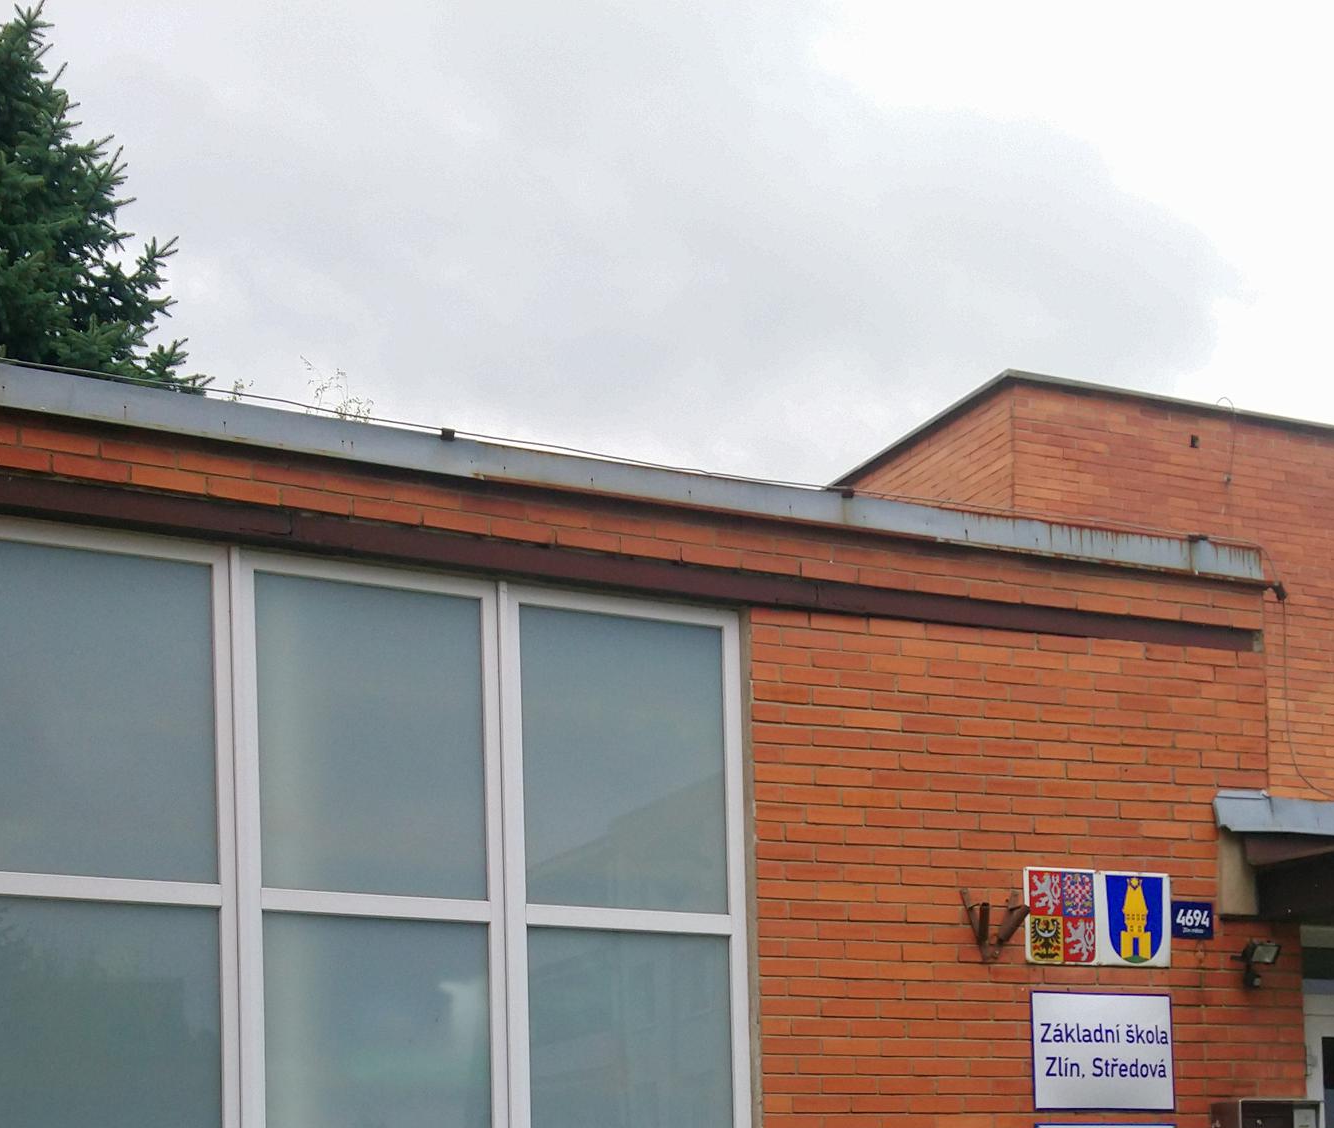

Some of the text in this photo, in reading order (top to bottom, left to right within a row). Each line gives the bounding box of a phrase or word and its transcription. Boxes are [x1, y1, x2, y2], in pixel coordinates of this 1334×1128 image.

[1176, 909, 1210, 927] 4694
[1040, 1023, 1168, 1044] Základní škola
[1045, 1057, 1166, 1078] Zlín, Středová
